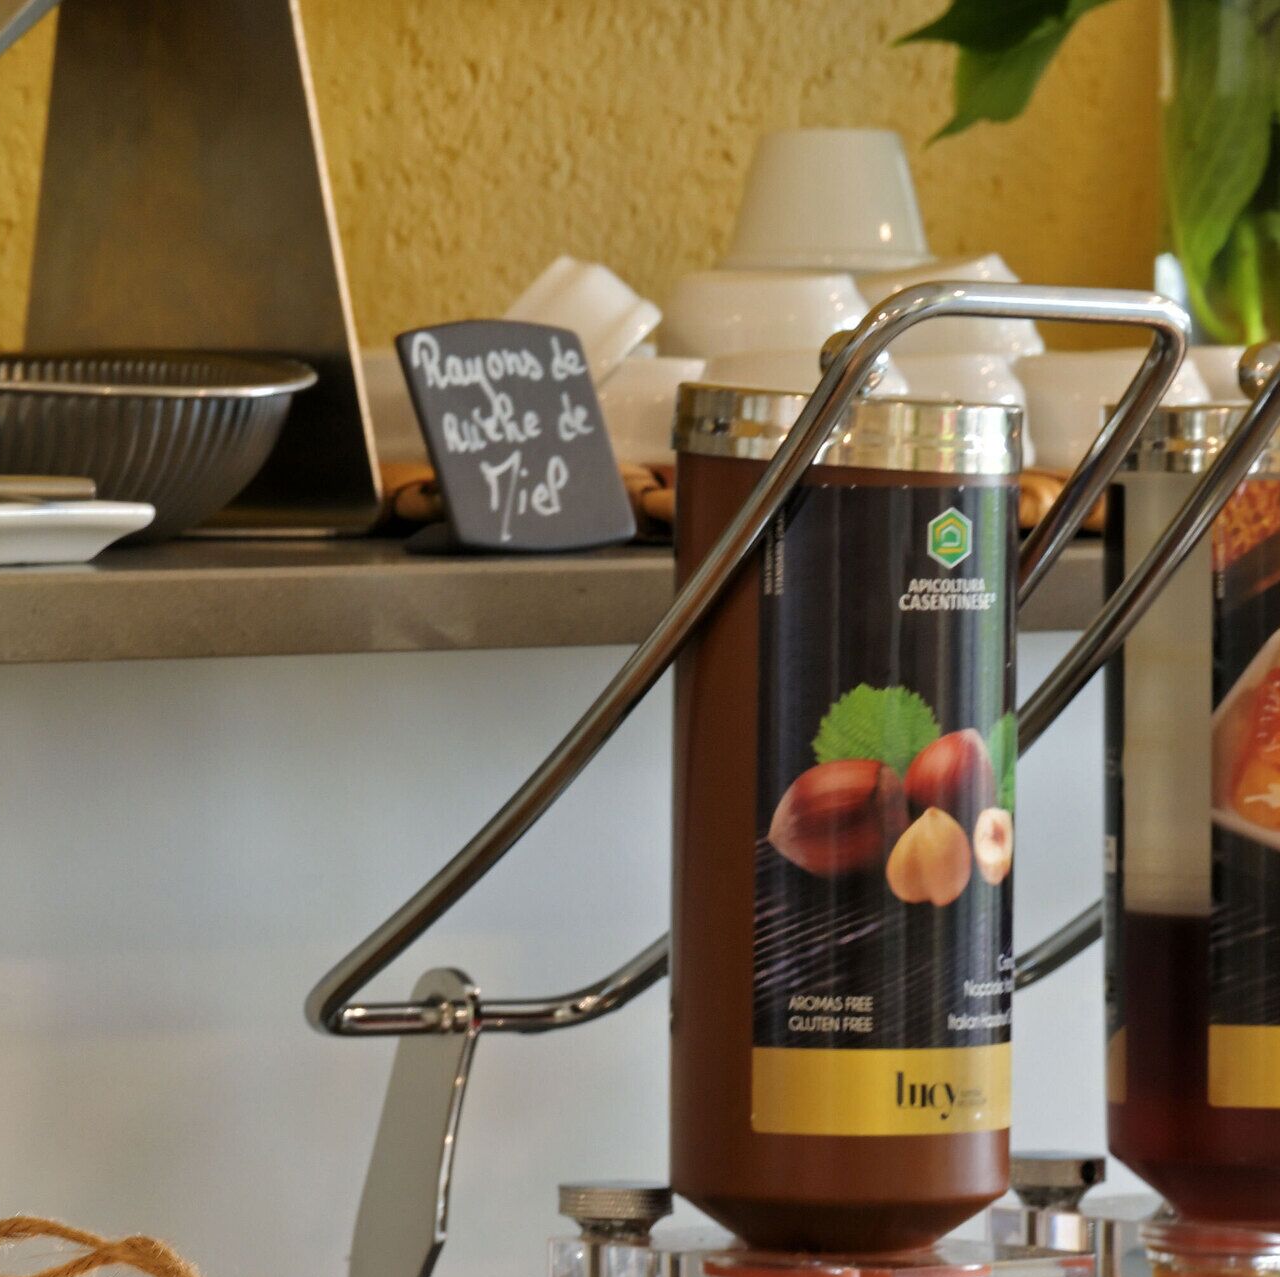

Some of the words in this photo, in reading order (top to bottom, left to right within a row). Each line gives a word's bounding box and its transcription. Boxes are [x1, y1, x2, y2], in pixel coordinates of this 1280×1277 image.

[551, 335, 587, 381] de
[558, 393, 593, 441] de
[908, 578, 986, 593] APICOLTURA
[788, 996, 843, 1012] AROMAS
[845, 995, 874, 1012] FREE
[788, 1015, 841, 1032] GLUTEN
[843, 1015, 874, 1032] FREE
